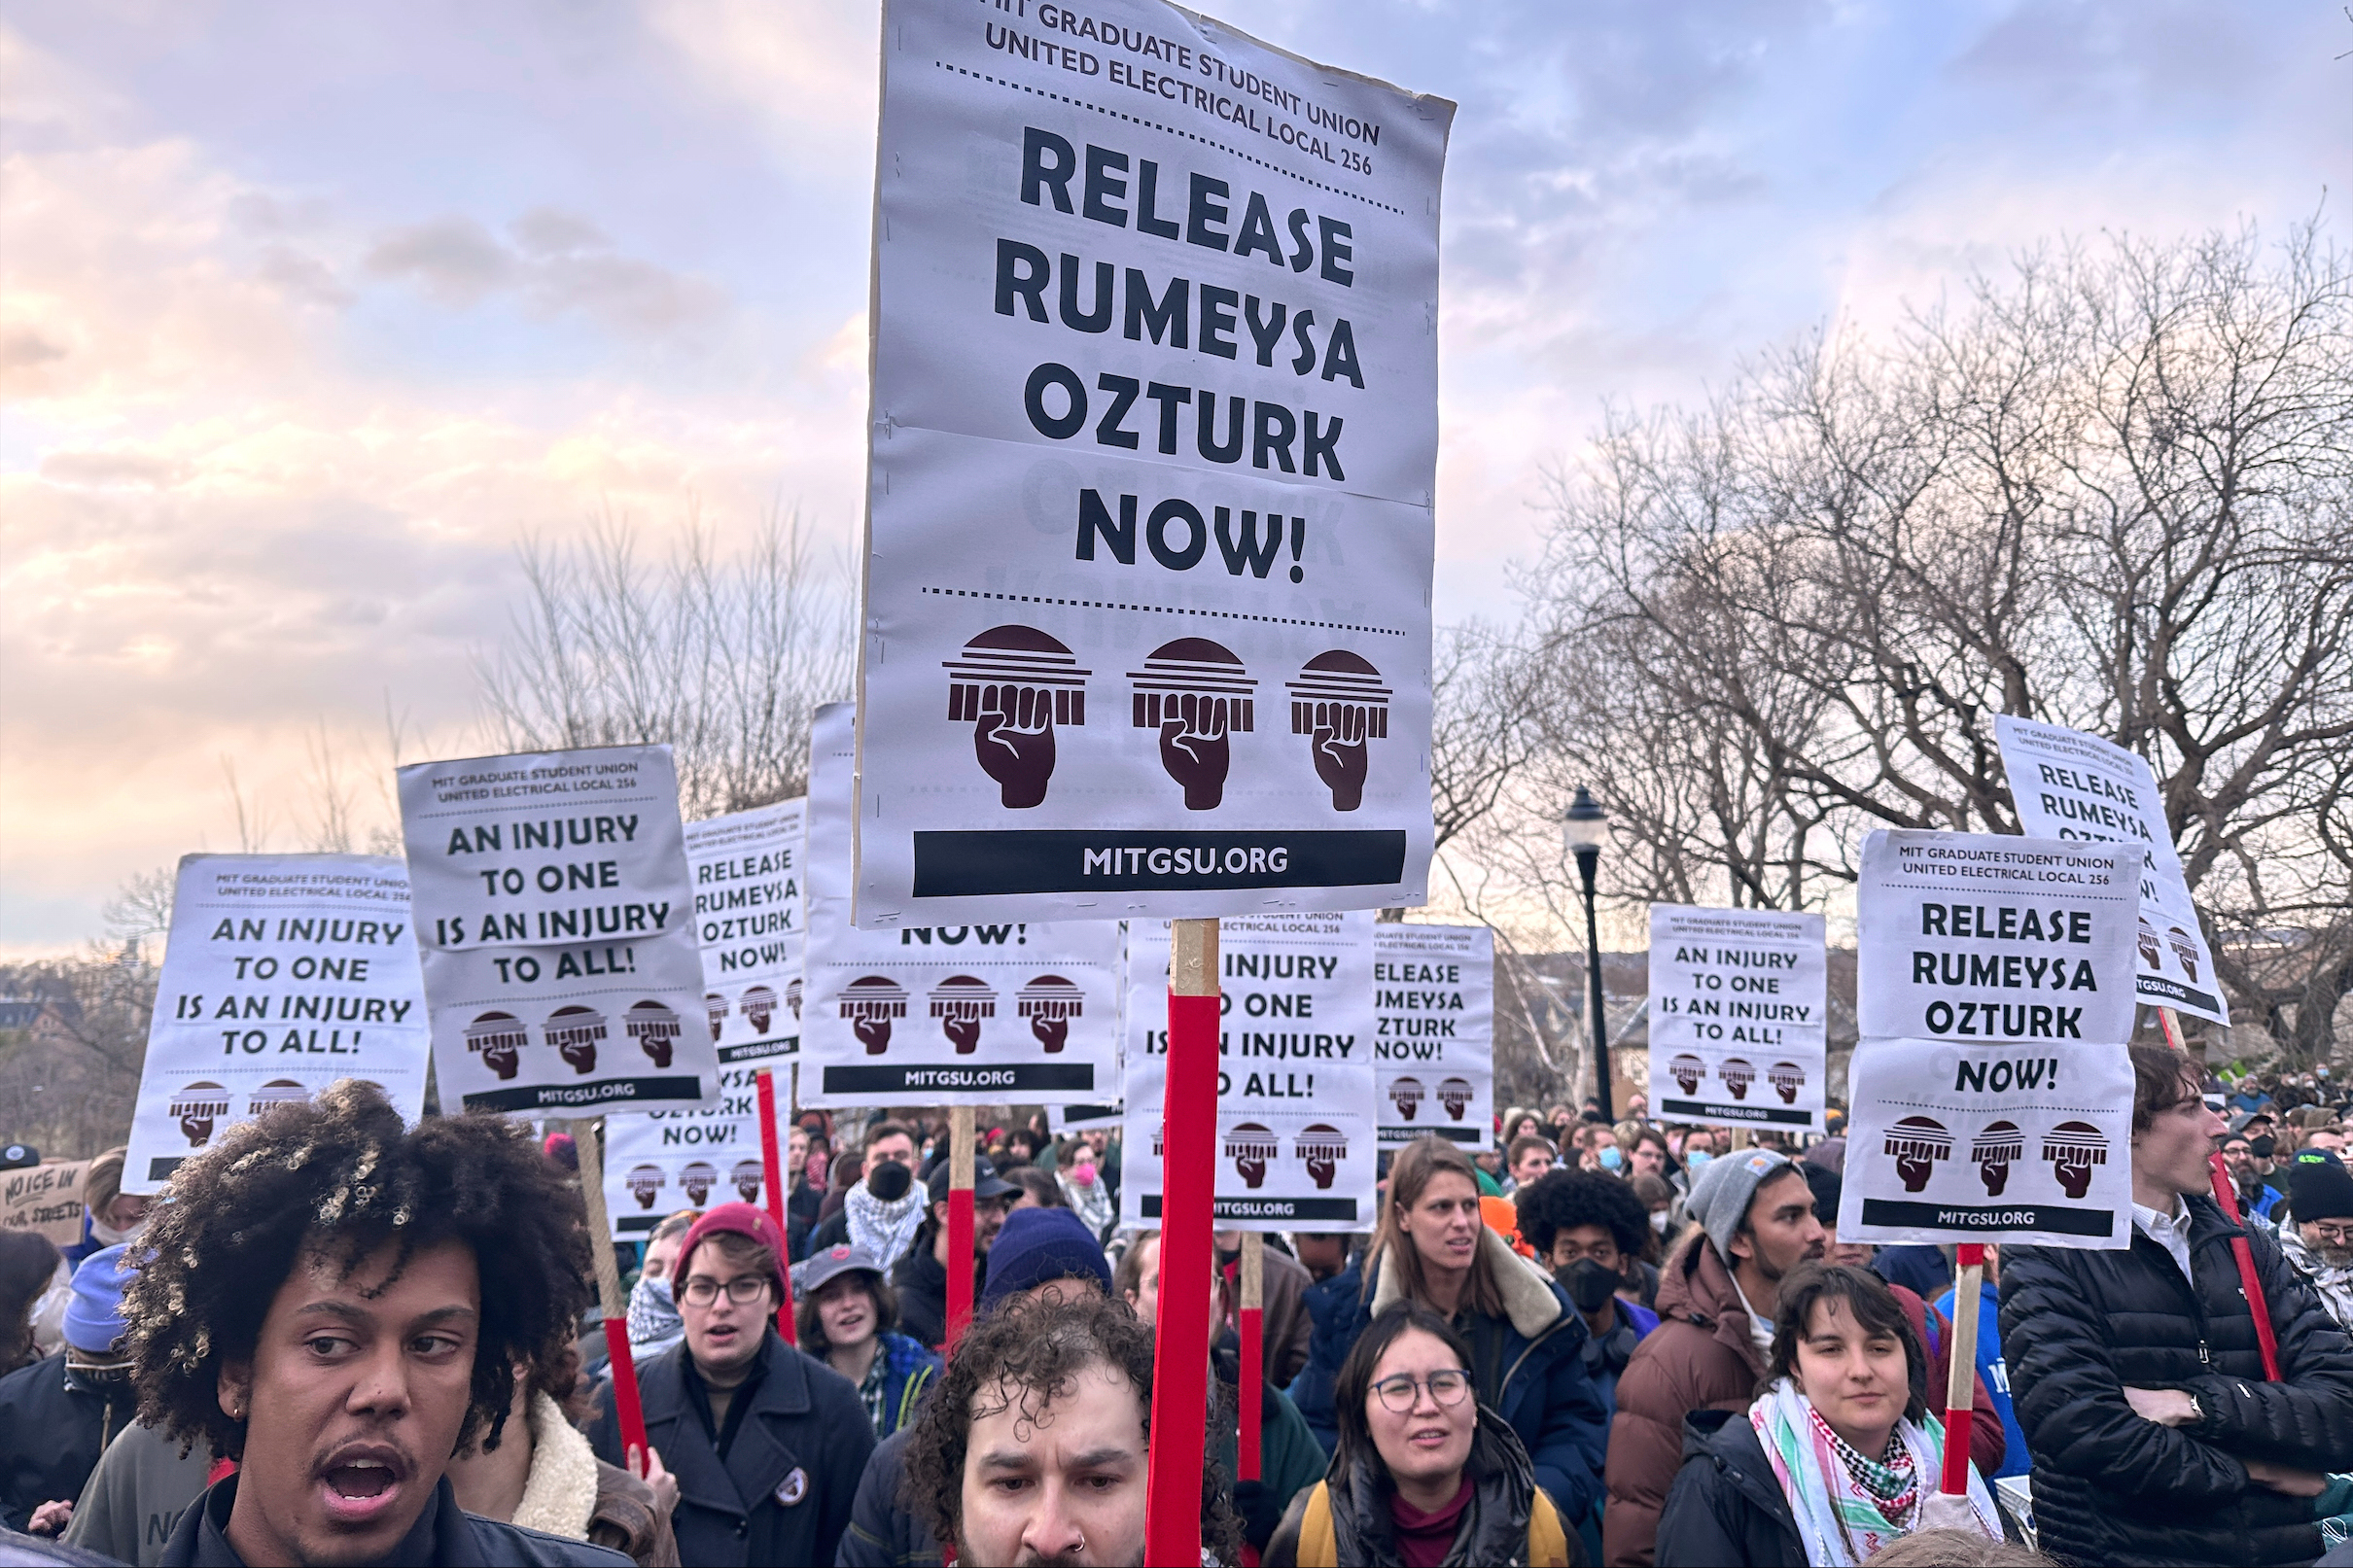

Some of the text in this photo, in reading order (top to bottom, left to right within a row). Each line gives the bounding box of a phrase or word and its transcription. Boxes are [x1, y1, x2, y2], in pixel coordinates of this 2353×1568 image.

[1038, 4, 1192, 71] GRADUATE
[1199, 53, 1301, 116] STUDENT
[1307, 102, 1380, 146] UNION
[986, 21, 1372, 176] UNITED ELECTRICAL LOCAL 256
[1020, 126, 1354, 288] RELEASE
[994, 237, 1366, 390] RUMEYSA
[1024, 362, 1346, 482] OZTURK
[1075, 488, 1305, 584] NOW!
[2030, 730, 2077, 746] GRADUATE
[432, 762, 639, 788] MIT GRADUATE STUDENT UNION
[2038, 763, 2138, 811] RELEASE
[438, 778, 637, 803] UNITED ELECTRICAL LOCAL 256
[2041, 793, 2154, 844] RUMEYSA
[447, 815, 639, 855] AN INJURY
[699, 849, 792, 885] RELEASE
[1082, 846, 1289, 876] MITGSU.ORG
[1899, 847, 2115, 869] MIT GRADUATE STUDENT UNION
[216, 874, 408, 889] MIT GRADUATE STUDENT UNIO
[480, 860, 619, 896] TO ONE
[1903, 863, 2110, 886] UNITED ELECTRICAL LOCAL 256
[218, 888, 266, 896] UNITED
[269, 889, 343, 898] ELECTRICAL
[346, 889, 389, 900] LOCAL
[695, 878, 797, 914] RUMEYSA
[437, 902, 669, 945] IS AN INJURY
[703, 908, 791, 941] OZTURK
[1219, 922, 1279, 931] LECTRICAL
[1282, 923, 1320, 933] LOCAL
[1306, 912, 1343, 922] UNION
[1687, 918, 1731, 927] GRADUATE
[1733, 920, 1771, 929] STUDENT
[1922, 903, 2091, 944] RELEASE
[211, 919, 404, 945] AN INJURY
[233, 957, 369, 982] TO ONE
[494, 947, 636, 984] TO ALL!
[720, 942, 787, 972] NOW!
[1226, 954, 1337, 981] INJURY
[1674, 947, 1798, 969] AN INJURY
[1375, 962, 1459, 984] ELEASE
[1692, 973, 1779, 994] TO ONE
[1913, 951, 2097, 992] RUMEYSA
[2136, 979, 2186, 998] TGSU.ORG
[176, 994, 411, 1023] IS AN INJURY
[1245, 993, 1313, 1018] ONE
[1662, 996, 1809, 1021] IS AN INJURY
[1378, 1018, 1456, 1037] ZTURK
[1925, 1000, 2083, 1039] OZTURK
[222, 1029, 362, 1055] TO ALL!
[1146, 1030, 1168, 1055] IS
[1243, 1032, 1354, 1061] INJURY
[1694, 1023, 1781, 1045] TO ALL!
[730, 1042, 790, 1060] MITGSU.ORG
[1375, 1041, 1442, 1061] NOW!
[904, 1071, 1015, 1087] MITGSU.ORG
[1244, 1073, 1313, 1097] ALL!
[1954, 1058, 2057, 1093] NOW!
[538, 1083, 635, 1103] MITGSU.ORG
[1705, 1106, 1768, 1119] MITGSU.ORG
[663, 1125, 737, 1146] NOW!
[26, 1168, 54, 1194] ICE
[1214, 1202, 1295, 1215] ITGSU.ORG
[1938, 1210, 2035, 1226] MITGSU.ORG
